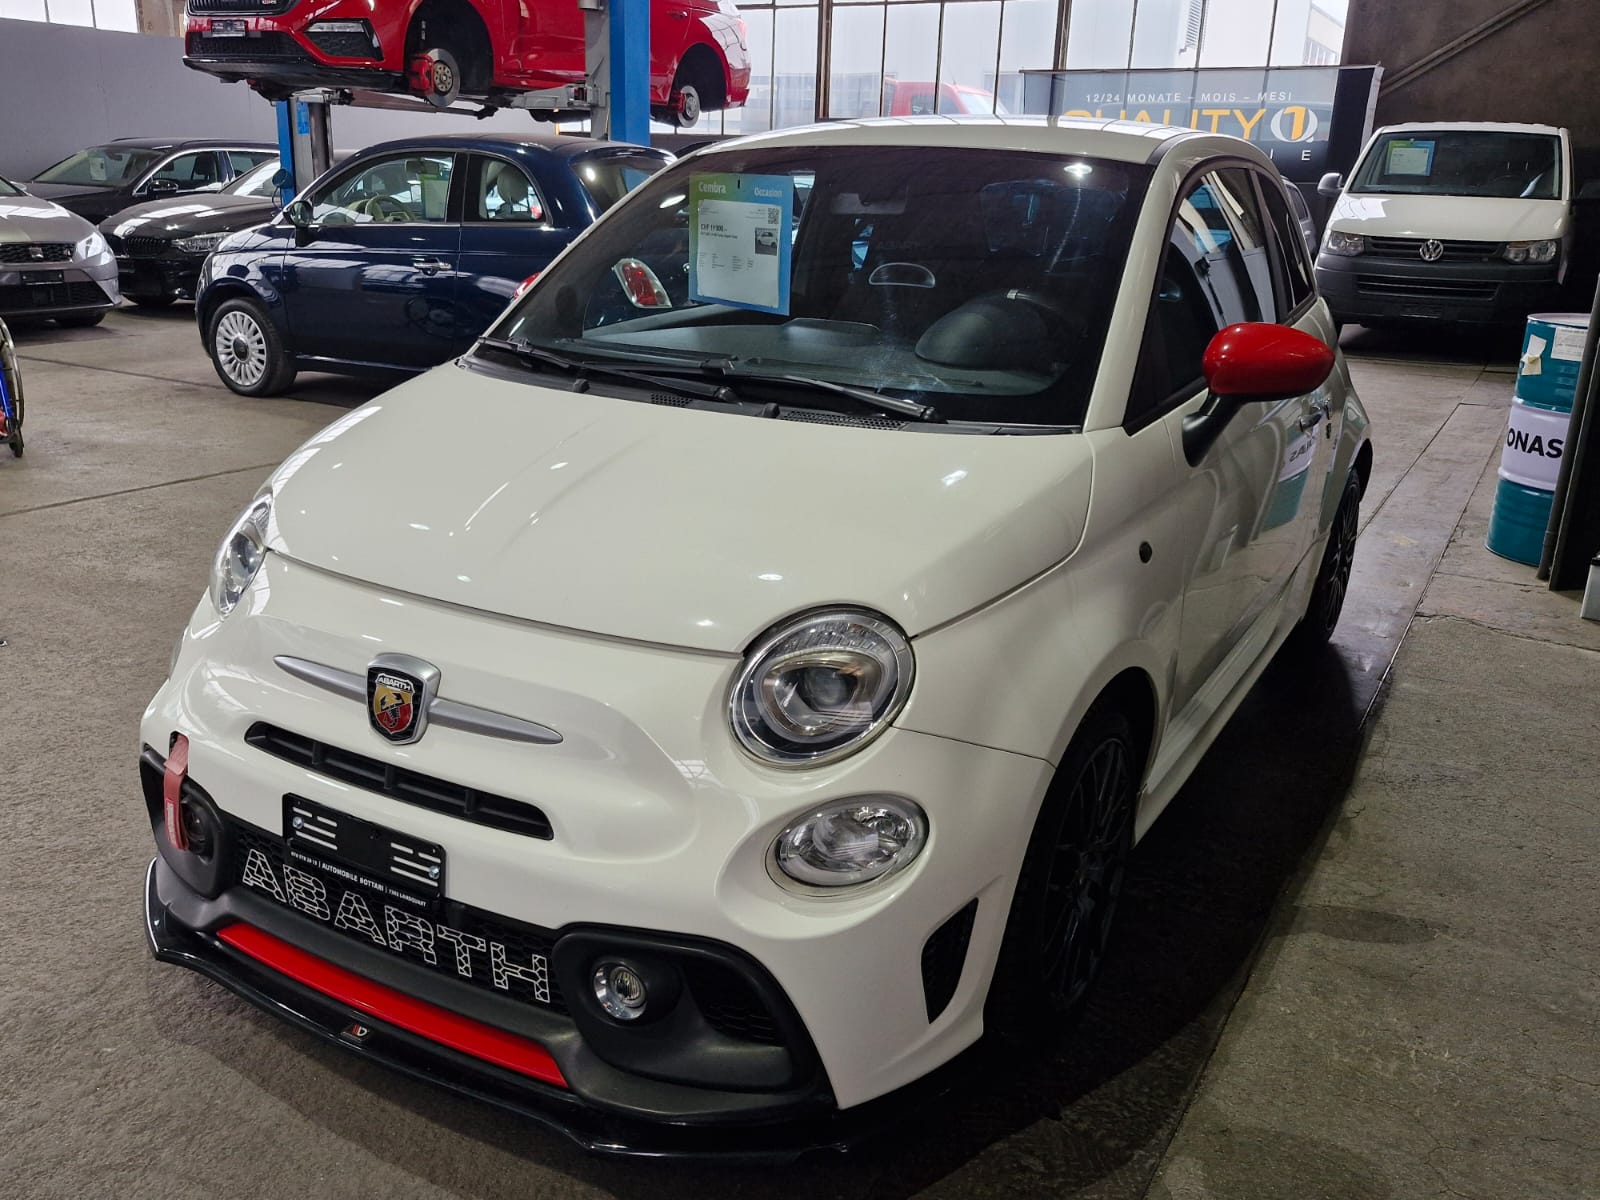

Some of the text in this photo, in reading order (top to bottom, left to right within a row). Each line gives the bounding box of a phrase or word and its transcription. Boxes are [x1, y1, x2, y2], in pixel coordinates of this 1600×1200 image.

[1086, 91, 1292, 103] 12/24 MONATE MOIS MESI
[699, 181, 783, 197] Cembra Occasion
[378, 677, 411, 691] ABARTH
[322, 862, 358, 882] AUTOMOBILE
[359, 877, 384, 892] BOTTARI
[242, 848, 551, 1003] ABARTH
